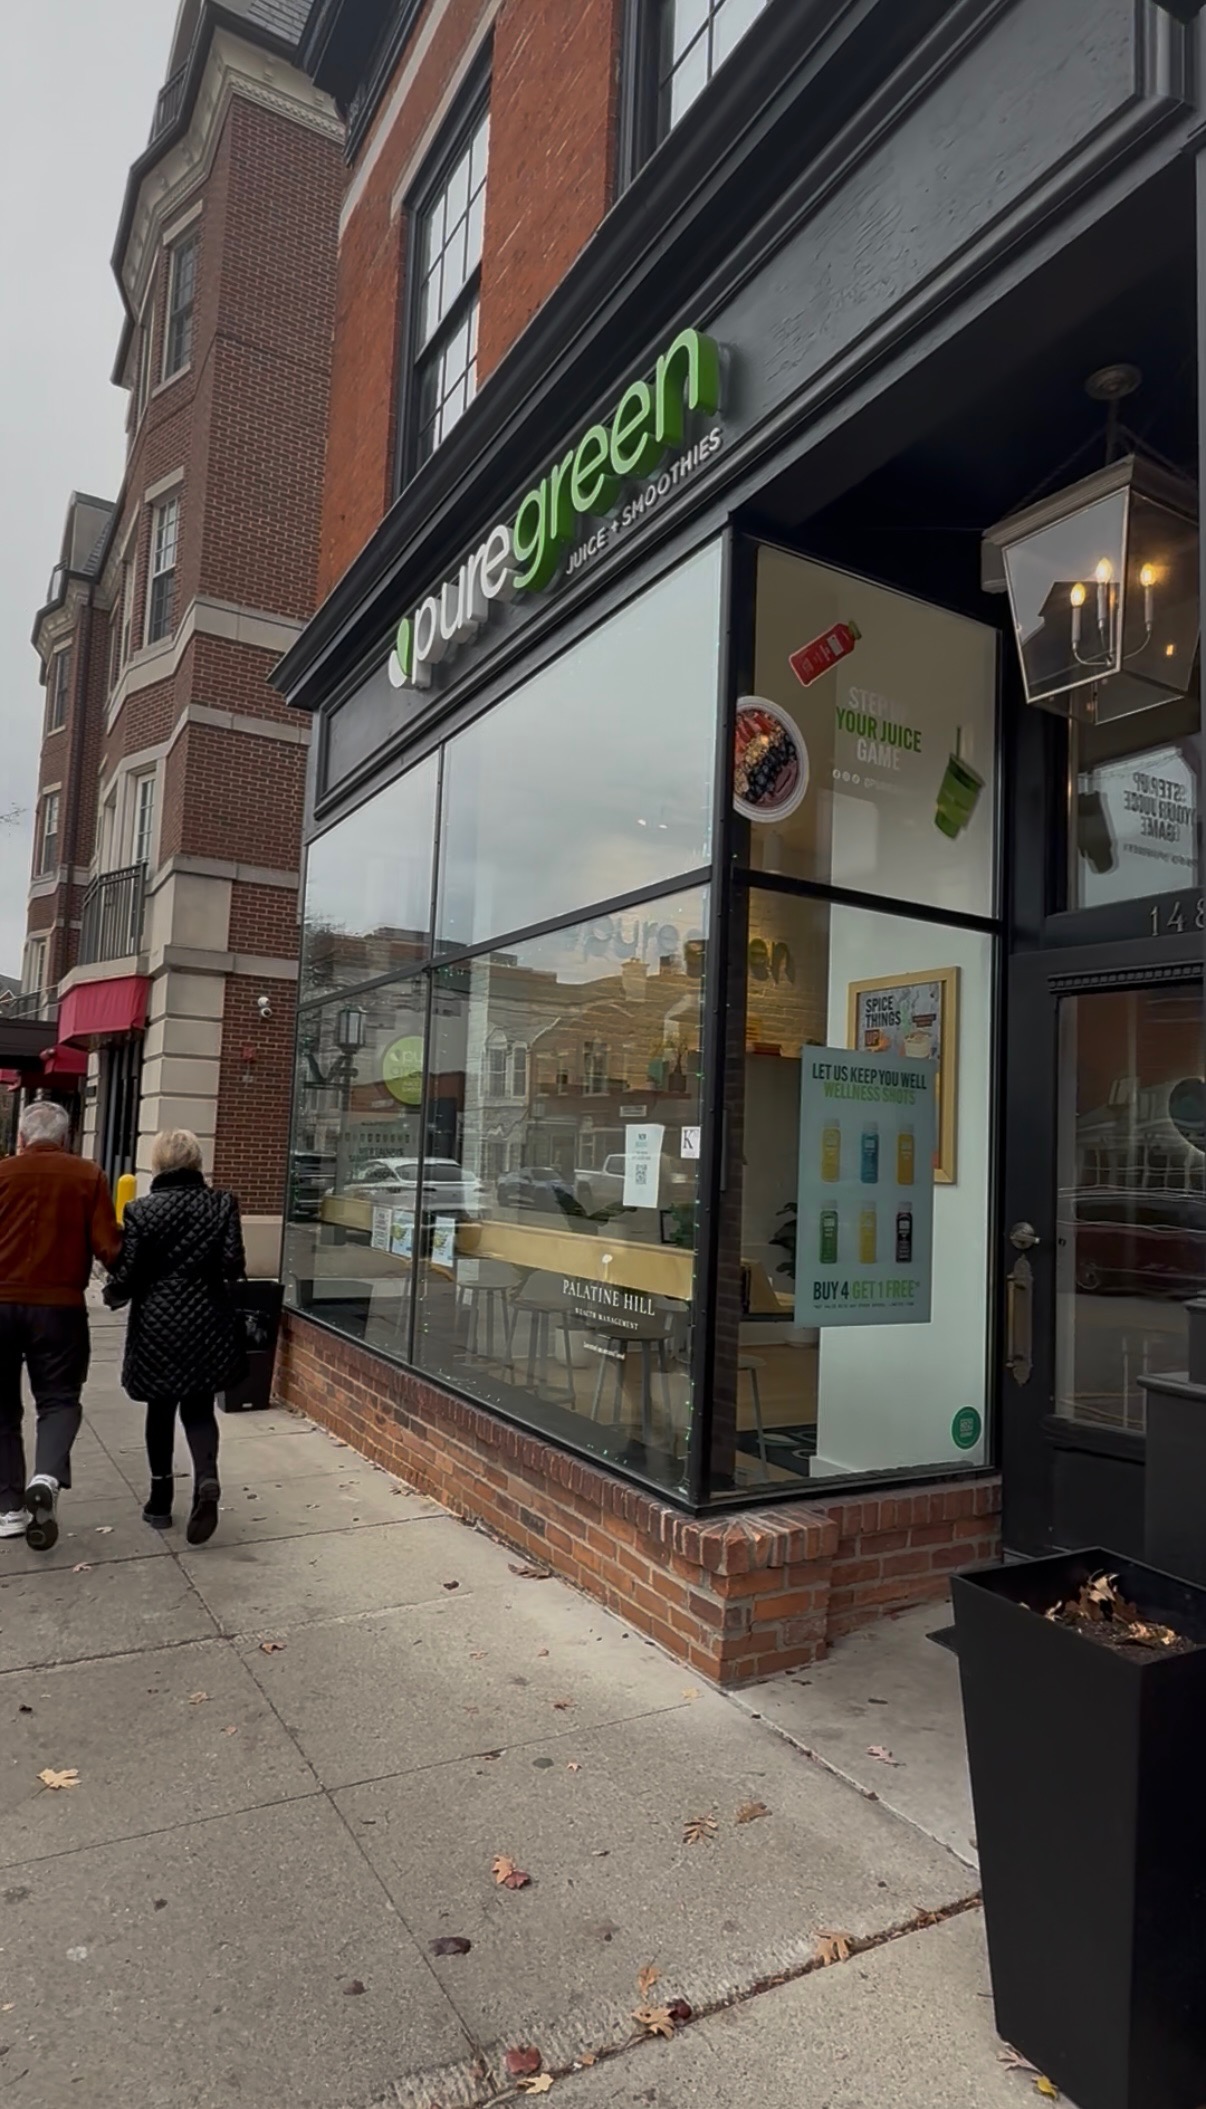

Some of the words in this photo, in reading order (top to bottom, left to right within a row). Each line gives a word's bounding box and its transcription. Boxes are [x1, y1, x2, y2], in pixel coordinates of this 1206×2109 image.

[411, 328, 719, 690] puregreen
[565, 527, 606, 576] JUICE
[621, 427, 723, 527] SMOOTHIES
[848, 686, 889, 717] STEP
[836, 705, 878, 741] YOUR
[880, 720, 923, 753] JUICE
[856, 737, 901, 771] GAME
[865, 996, 894, 1013] SPICE
[865, 1011, 901, 1028] THINGS
[812, 1063, 832, 1080] LET
[834, 1065, 848, 1081] US
[850, 1067, 878, 1084] KEEP
[879, 1070, 899, 1087] YOU
[900, 1073, 927, 1090] WELL
[823, 1081, 881, 1102] WELLNESS
[882, 1087, 917, 1105] SHOTS
[562, 1279, 620, 1308] PALATINE
[623, 1293, 656, 1316] HILL
[813, 1281, 839, 1301] BUY
[841, 1281, 849, 1300] 4
[852, 1281, 876, 1300] GET
